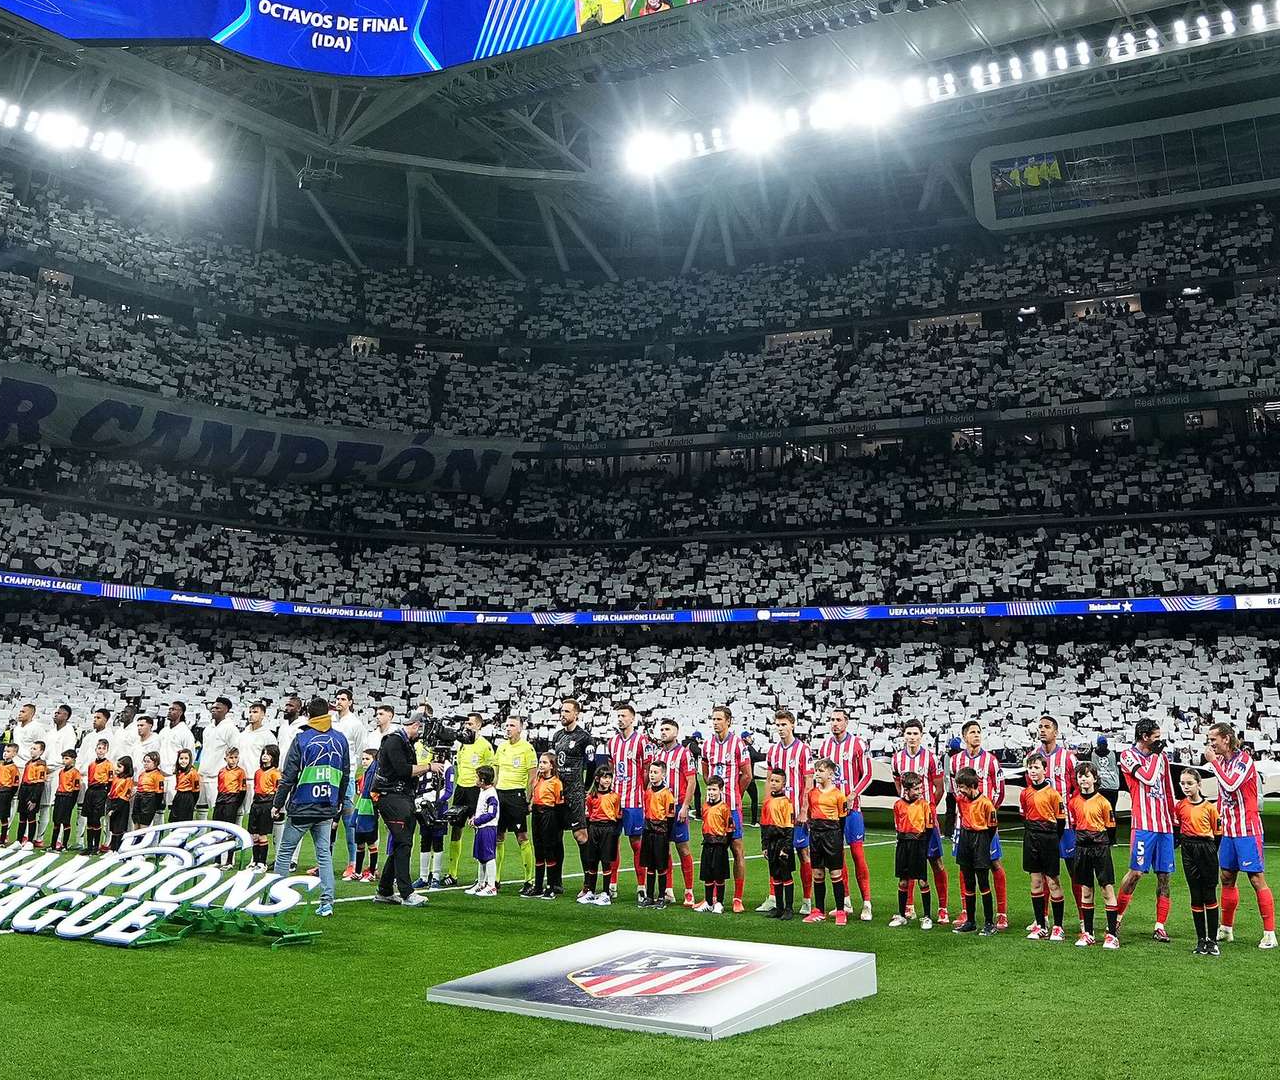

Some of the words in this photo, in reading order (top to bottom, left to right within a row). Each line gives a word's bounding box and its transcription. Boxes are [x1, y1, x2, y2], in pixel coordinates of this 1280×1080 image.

[258, 0, 333, 30] OCTAVOS
[336, 16, 360, 32] DE
[362, 16, 408, 34] FINAL
[311, 31, 352, 53] (IDA)
[1247, 388, 1270, 398] Real
[70, 392, 502, 493] CAMPEÓN
[4, 575, 51, 588] CHAMPIONS
[52, 581, 82, 591] LEAGUE
[294, 605, 310, 614] UEFA
[311, 607, 353, 617] CHAMPIONS
[354, 609, 383, 618] LEAGUE
[610, 613, 648, 621] CHAMPIONS
[649, 612, 674, 620] LEAGUE
[889, 607, 908, 617] UEFA
[909, 606, 954, 616] CHAMPIONS
[955, 605, 986, 615] LEAGUE
[119, 826, 234, 866] UEFA
[1137, 841, 1145, 855] 5
